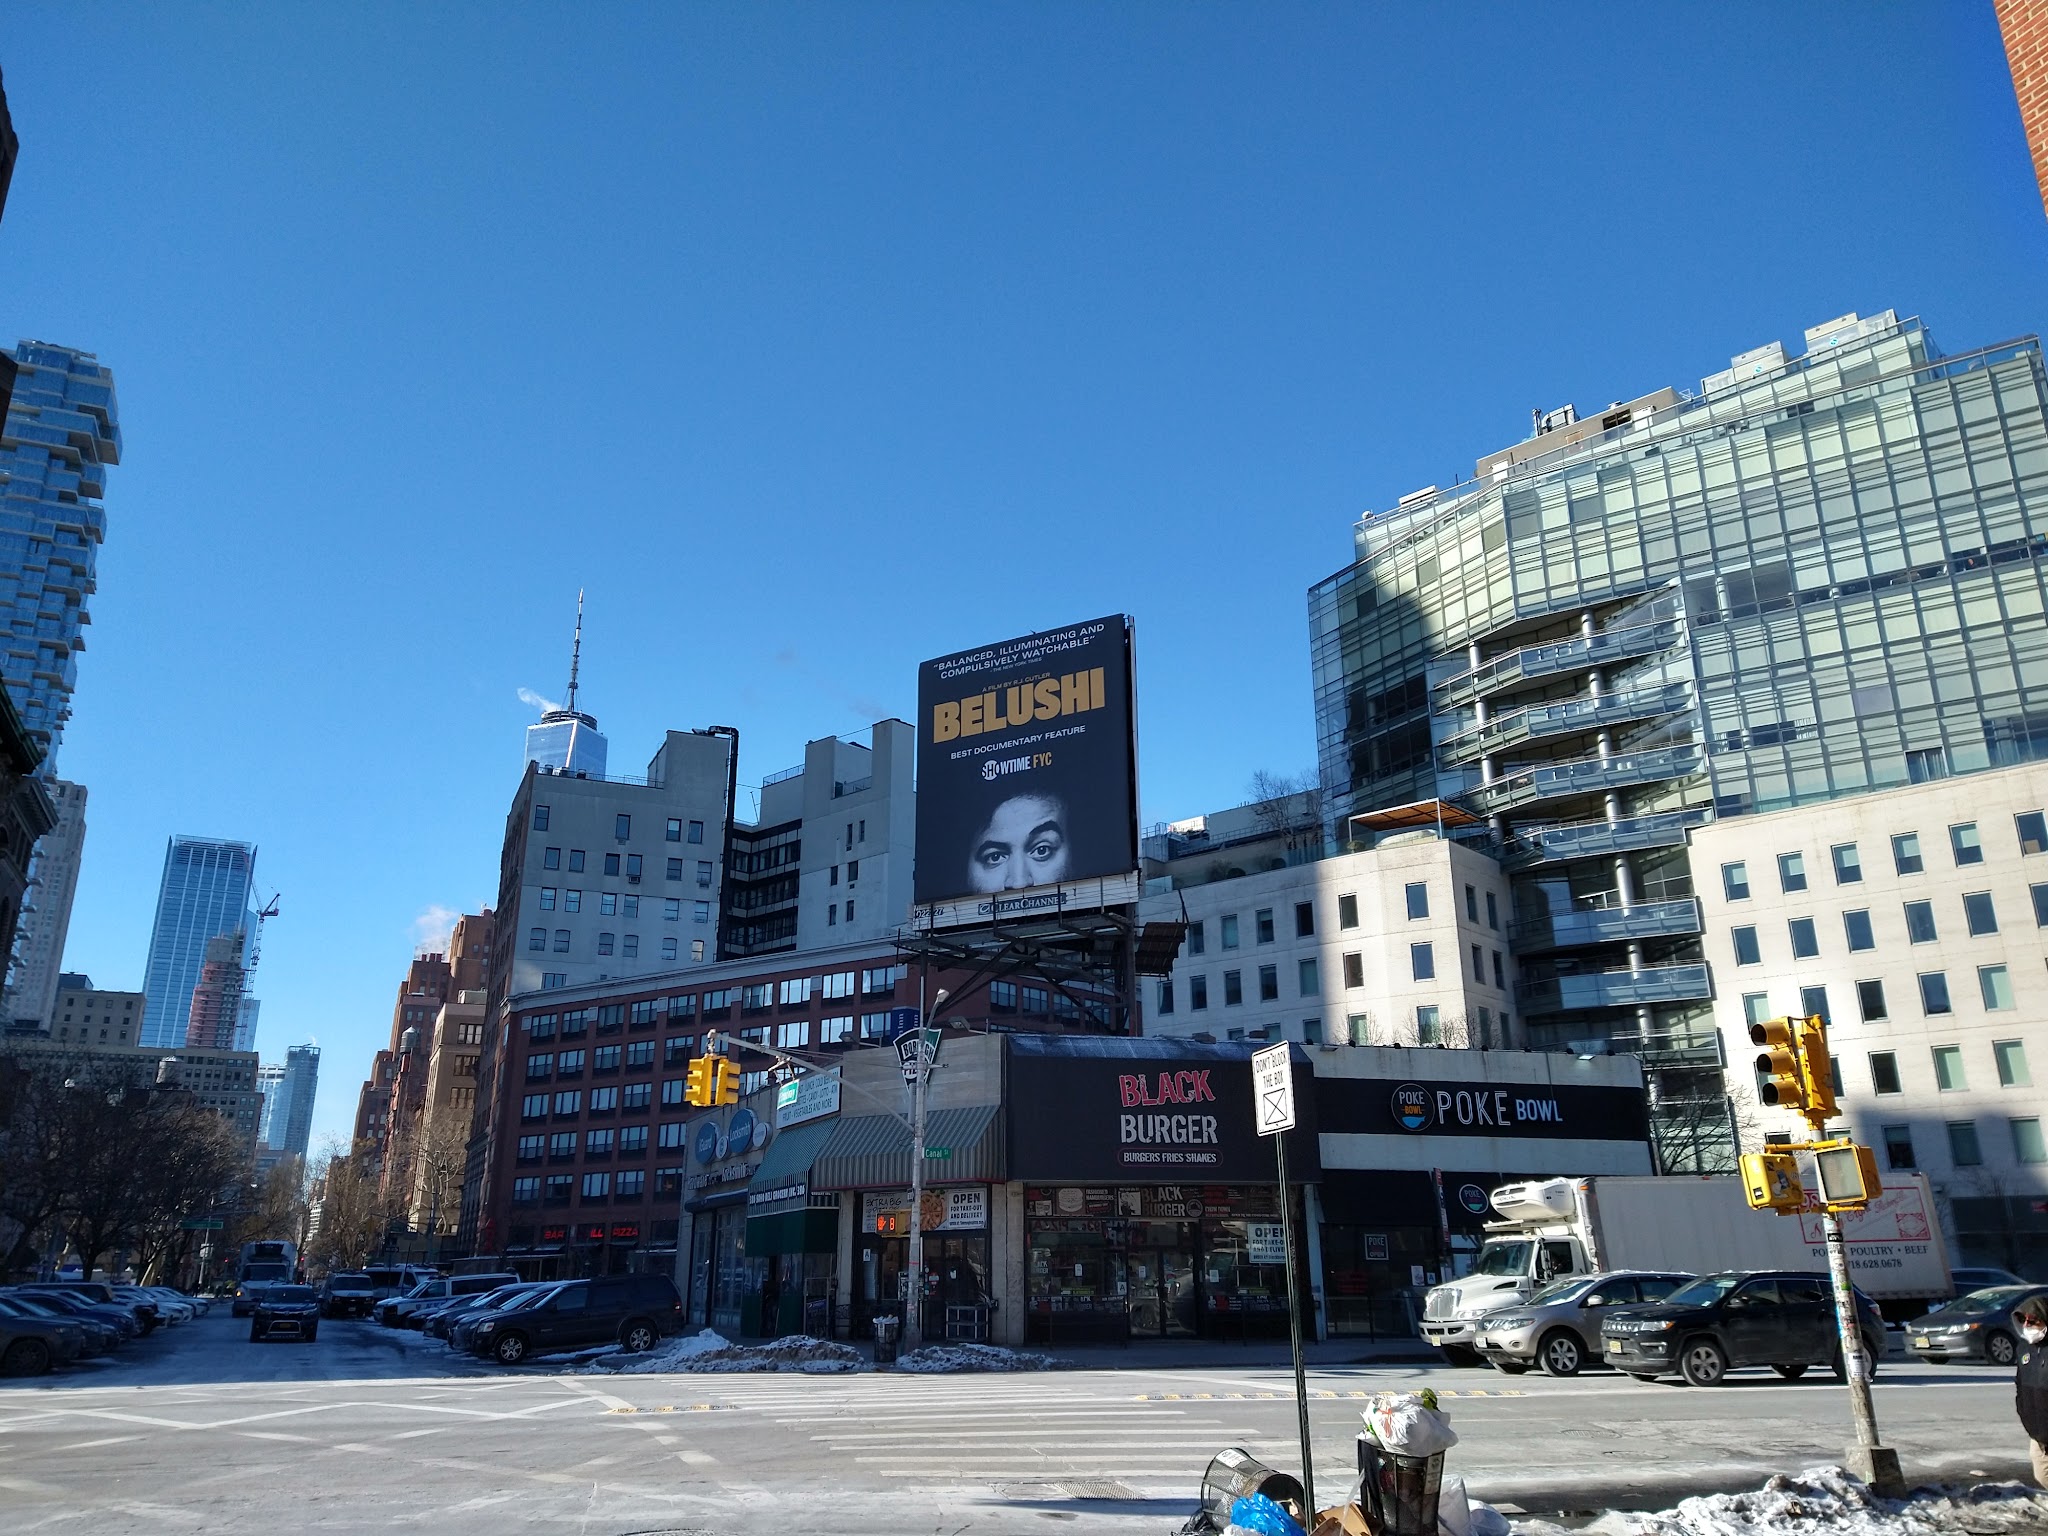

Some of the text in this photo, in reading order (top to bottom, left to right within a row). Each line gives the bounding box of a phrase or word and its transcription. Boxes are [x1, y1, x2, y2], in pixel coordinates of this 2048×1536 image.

[999, 629, 1076, 656] ILLUMINATING
[1079, 623, 1105, 636] AND
[940, 655, 1018, 680] COMPULSIVELY
[987, 683, 1002, 692] FILM
[1003, 681, 1012, 689] BY
[1024, 672, 1051, 684] CUTLER
[933, 667, 1105, 744] BELUSHI
[950, 724, 1086, 760] BEST DOCUMENTARY FEATURE
[981, 752, 1052, 781] SHOWTIME FYC
[901, 1040, 935, 1062] BORGH
[1255, 1050, 1288, 1073] DON'T BLOCK
[1263, 1070, 1284, 1088] THE BOX
[1119, 1069, 1216, 1108] BLACK
[1399, 1091, 1425, 1105] POKE
[1404, 1106, 1423, 1114] BOWL
[1515, 1099, 1563, 1122] BOWL
[730, 1121, 751, 1142] Locksmith
[1120, 1114, 1218, 1144] BURGER
[925, 1149, 942, 1158] Canal
[1123, 1152, 1217, 1163] BURGERS FRIES SHAKES
[953, 1193, 980, 1204] OPEN
[1141, 1186, 1184, 1203] BLACK
[1464, 1189, 1481, 1198] POKE
[866, 1198, 888, 1207] EXTRA
[960, 1204, 983, 1212] TAKE-OUT
[1143, 1203, 1186, 1217] BURGER
[889, 1217, 895, 1231] 8
[544, 1230, 565, 1239] BAR
[612, 1227, 639, 1237] PIZZA
[1368, 1237, 1385, 1246] POKE
[1850, 1246, 1893, 1256] POULTRY
[1904, 1245, 1928, 1255] BEEF
[1848, 1259, 1903, 1270] 18.628.0678
